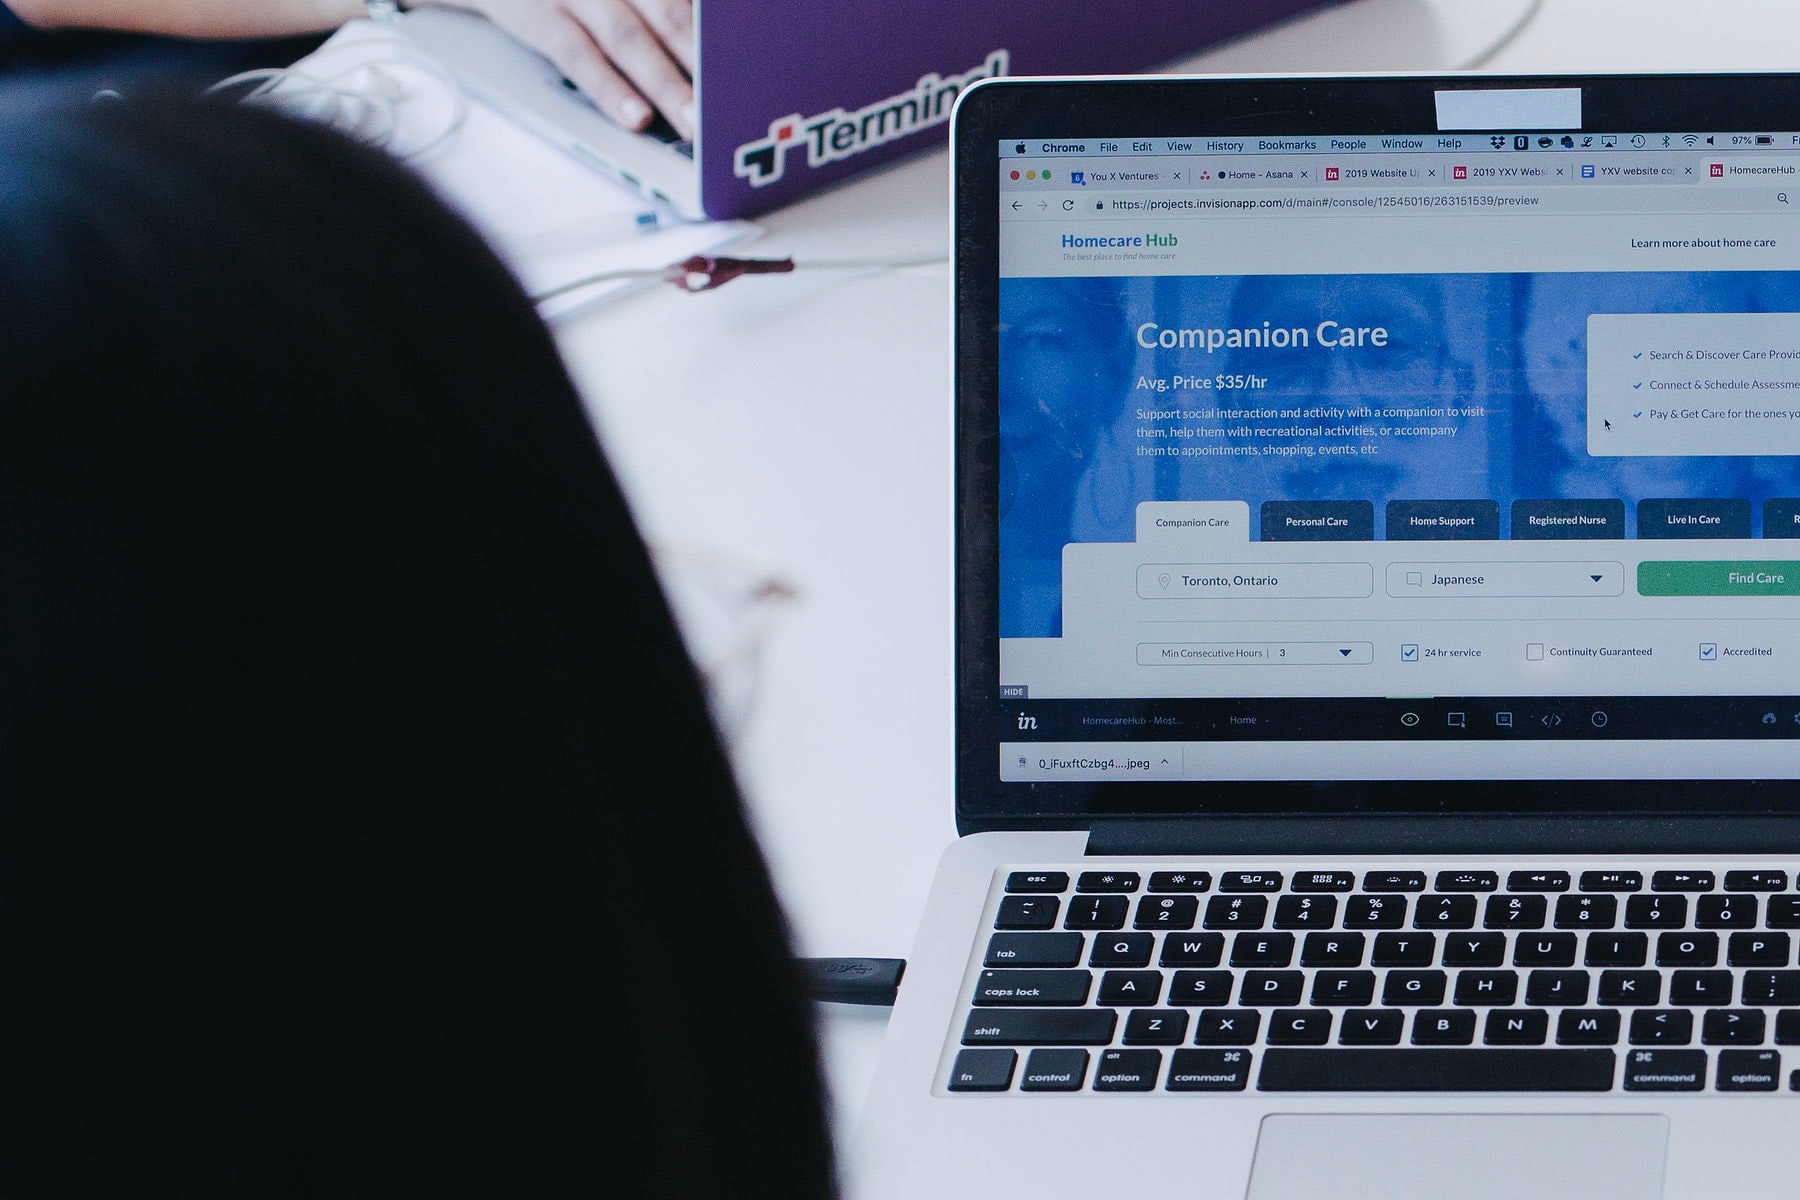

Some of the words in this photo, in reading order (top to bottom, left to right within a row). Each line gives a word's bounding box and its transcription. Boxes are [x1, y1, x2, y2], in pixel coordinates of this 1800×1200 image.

[806, 58, 1002, 156] Termin
[1042, 143, 1085, 153] Chrome
[1100, 142, 1118, 152] File
[1133, 142, 1152, 152] Edit
[1167, 141, 1192, 151] View
[1207, 141, 1244, 152] History
[1259, 140, 1316, 150] Bookmarks
[1331, 139, 1366, 150] People
[1381, 139, 1423, 148] Window
[1438, 138, 1462, 149] Help
[1229, 171, 1256, 179] Home
[1265, 171, 1293, 179] Asana
[1730, 166, 1795, 174] HomecareHub
[1090, 173, 1107, 181] You
[1118, 172, 1159, 181] Ventures
[1062, 234, 1142, 248] Homecare
[1146, 233, 1178, 246] Hub
[1631, 239, 1660, 248] Learn
[1691, 238, 1721, 247] about
[1723, 238, 1752, 247] home
[1137, 321, 1308, 354] Companion
[1316, 321, 1388, 350] Care
[1650, 350, 1684, 360] Search
[1685, 350, 1693, 360] &
[1696, 350, 1740, 360] Discover
[1742, 350, 1767, 359] Care
[1136, 376, 1169, 392] Avg.
[1173, 375, 1212, 392] Price
[1216, 372, 1267, 392] $35/hr
[1649, 380, 1692, 390] Connect
[1694, 380, 1702, 390] &
[1704, 380, 1750, 390] Schedule
[1136, 409, 1180, 421] Support
[1183, 408, 1214, 419] social
[1217, 408, 1278, 418] interaction
[1280, 407, 1302, 418] and
[1303, 407, 1345, 419] activity
[1347, 407, 1372, 419] with
[1374, 409, 1380, 417] a
[1382, 406, 1444, 419] companion
[1447, 407, 1459, 416] to
[1461, 406, 1485, 416] visit
[1650, 409, 1668, 420] Pay
[1670, 409, 1678, 419] &
[1680, 409, 1699, 419] Get
[1701, 409, 1725, 419] Care
[1727, 409, 1742, 418] for
[1745, 409, 1761, 418] the
[1137, 427, 1167, 438] them,
[1170, 426, 1194, 439] help
[1196, 426, 1225, 437] them
[1227, 426, 1253, 437] with
[1254, 425, 1322, 437] recreational
[1324, 424, 1378, 437] activities,
[1380, 428, 1392, 436] or
[1394, 427, 1457, 437] accompany
[1155, 518, 1207, 528] Companion
[1208, 518, 1229, 527] Care
[1286, 517, 1325, 526] Personal
[1326, 517, 1348, 526] Care
[1410, 517, 1437, 525] Home
[1439, 516, 1475, 527] Support
[1529, 516, 1578, 526] Registered
[1579, 516, 1606, 524] Nurse
[1668, 515, 1687, 524] Live
[1688, 515, 1697, 524] In
[1699, 515, 1720, 524] Care
[1182, 576, 1231, 587] Toronto,
[1233, 575, 1278, 586] Ontario
[1432, 574, 1484, 586] Japanese
[1729, 572, 1754, 583] Find
[1756, 572, 1785, 584] Care
[1162, 649, 1179, 657] Min
[1180, 649, 1234, 658] Consecutive
[1236, 649, 1263, 657] Hours
[1280, 648, 1286, 657] 3
[1425, 648, 1436, 657] 24
[1450, 649, 1481, 657] service
[1550, 648, 1597, 657] Continuity
[1599, 647, 1652, 656] Guaranteed
[1723, 647, 1772, 656] Accredited
[1003, 688, 1023, 696] HIDE
[974, 1027, 1000, 1036] shift
[1101, 1073, 1141, 1083] option
[1175, 1074, 1236, 1083] command
